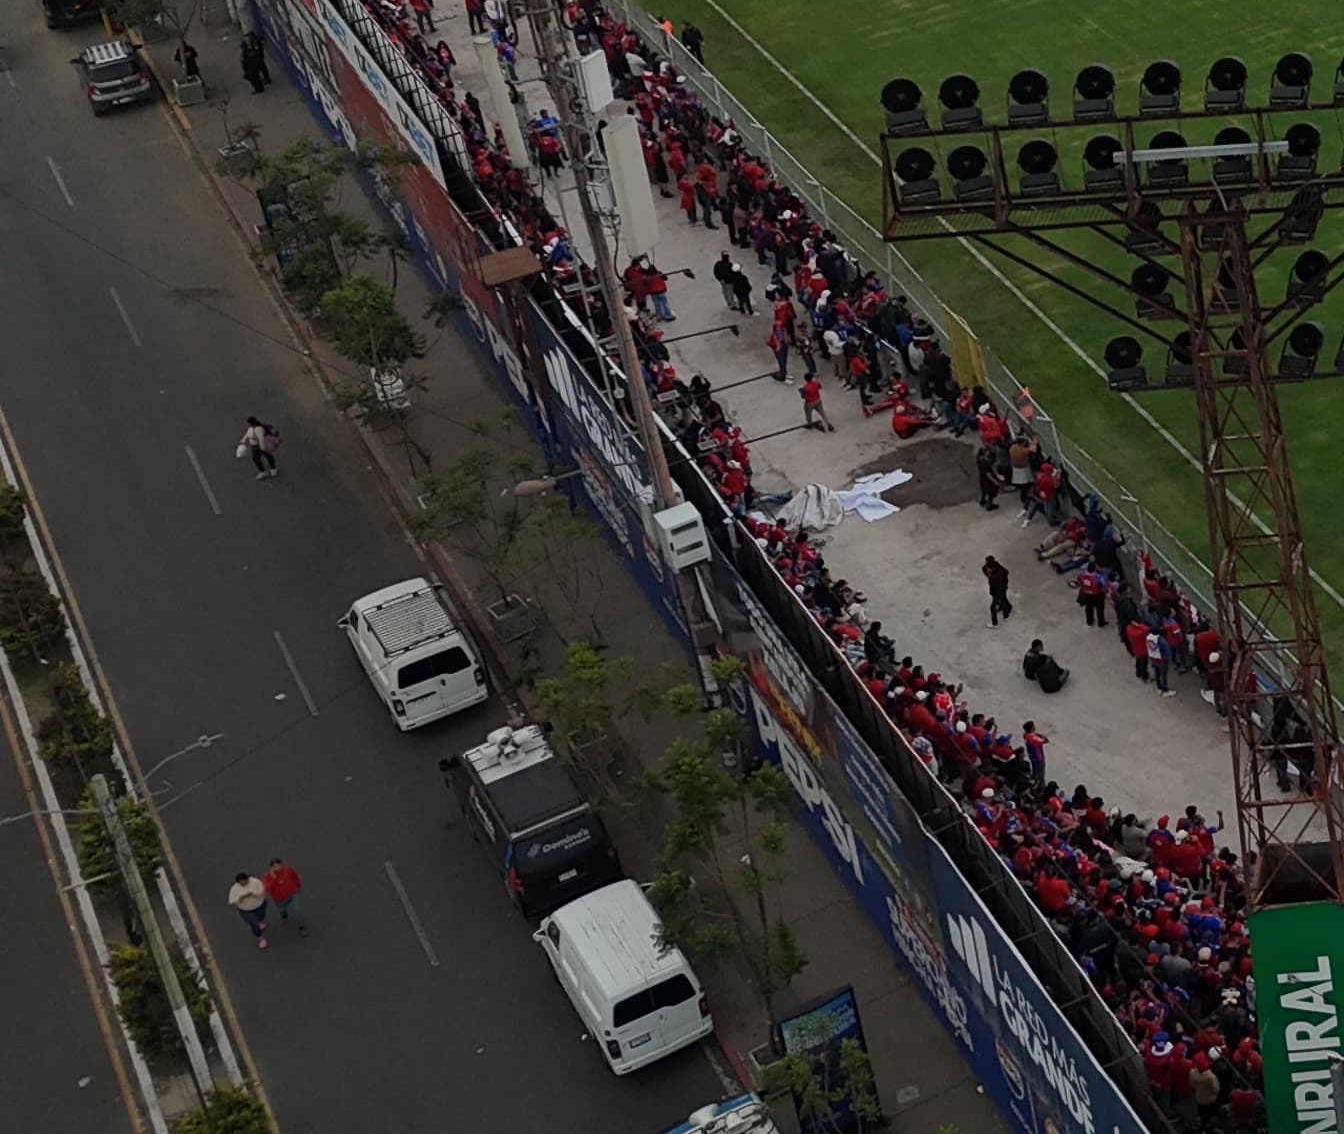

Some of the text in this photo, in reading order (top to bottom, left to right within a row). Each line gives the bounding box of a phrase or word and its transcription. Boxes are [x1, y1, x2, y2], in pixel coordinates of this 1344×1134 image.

[542, 827, 590, 854] Domino's
[750, 686, 865, 887] PEPSI
[993, 954, 1091, 1106] LA RED MÁS
[999, 990, 1096, 1134] GRANDE
[1277, 954, 1342, 1134] NRURAL
